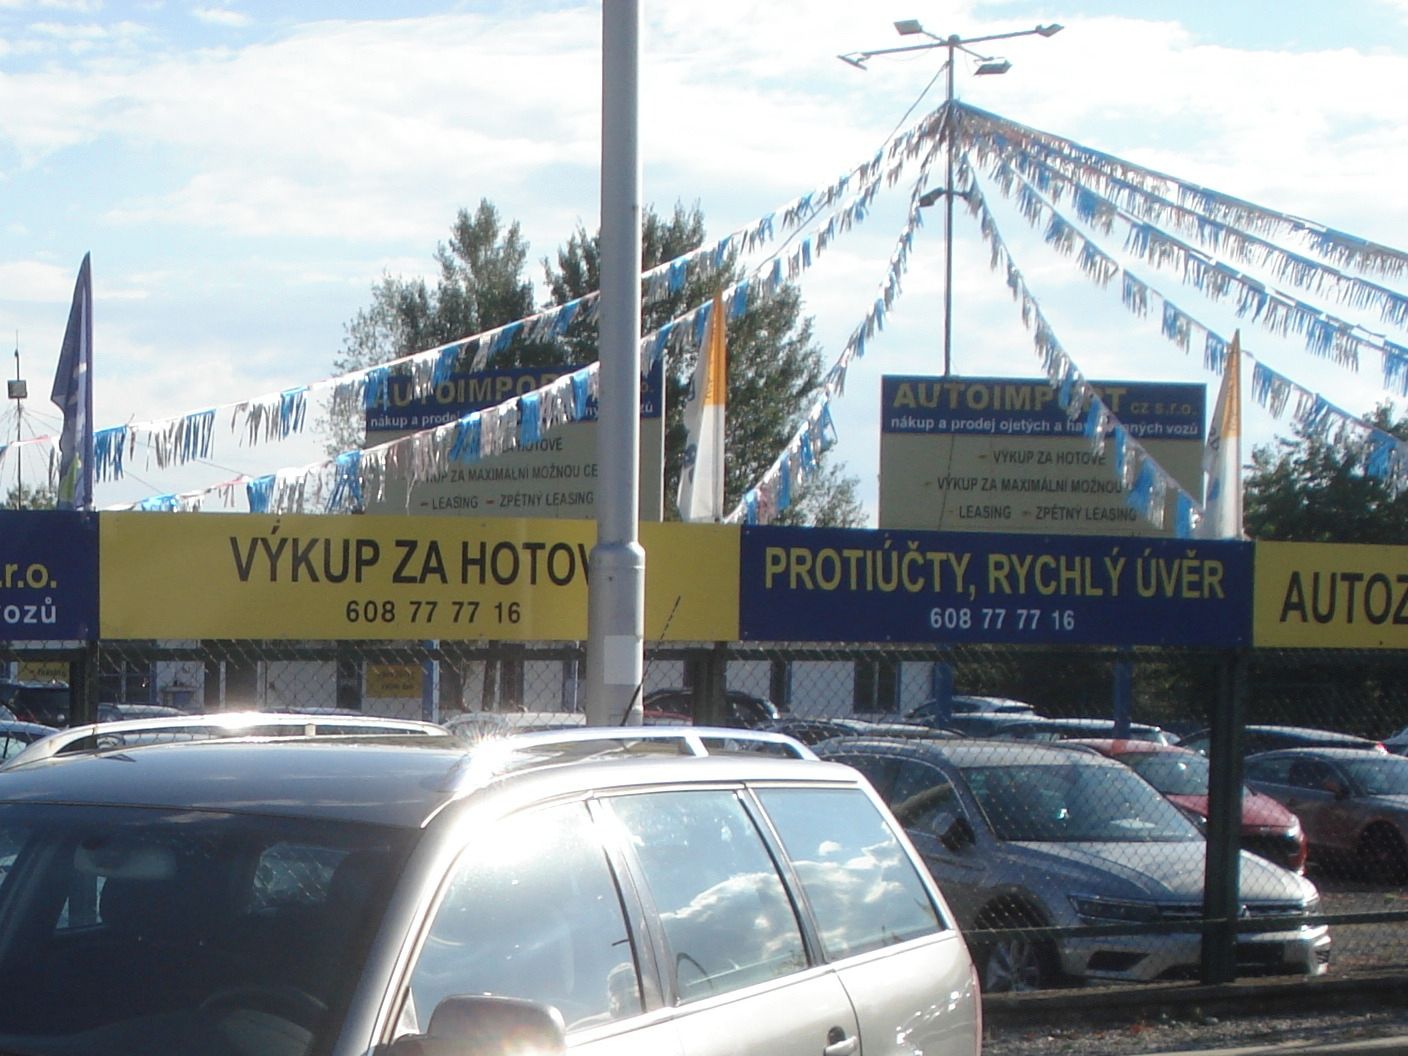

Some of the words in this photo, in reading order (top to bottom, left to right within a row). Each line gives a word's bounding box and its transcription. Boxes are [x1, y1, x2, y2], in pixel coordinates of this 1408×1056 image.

[1131, 402, 1150, 413] cz
[1155, 400, 1198, 415] s.r.o.
[370, 414, 406, 429] nákup
[891, 416, 934, 431] nákup
[939, 420, 947, 429] a
[951, 417, 995, 433] prodej
[1000, 418, 1051, 433] ojetých
[1054, 422, 1062, 431] a
[1167, 421, 1198, 436] vozů
[1037, 451, 1053, 465] ZA
[451, 469, 465, 482] ZA
[532, 462, 580, 479] MOŽNOU
[981, 477, 997, 491] ZA
[432, 495, 479, 510] LEASING
[545, 491, 594, 506] LEASING
[958, 504, 1011, 520] LEASING
[1085, 505, 1137, 522] LEASING
[229, 522, 380, 583] VÝKUP
[392, 539, 448, 585] ZA
[765, 539, 976, 601] PROTIÚČTY,
[988, 547, 1127, 596] RYCHLÝ
[1136, 547, 1224, 599] ÚVĚR
[345, 600, 396, 624] 608
[409, 600, 438, 624] 77
[451, 601, 481, 624] 77
[493, 602, 521, 624] 16
[930, 607, 972, 630] 608
[982, 608, 1007, 630] 77
[1016, 608, 1041, 631] 77
[1052, 609, 1075, 632] 16
